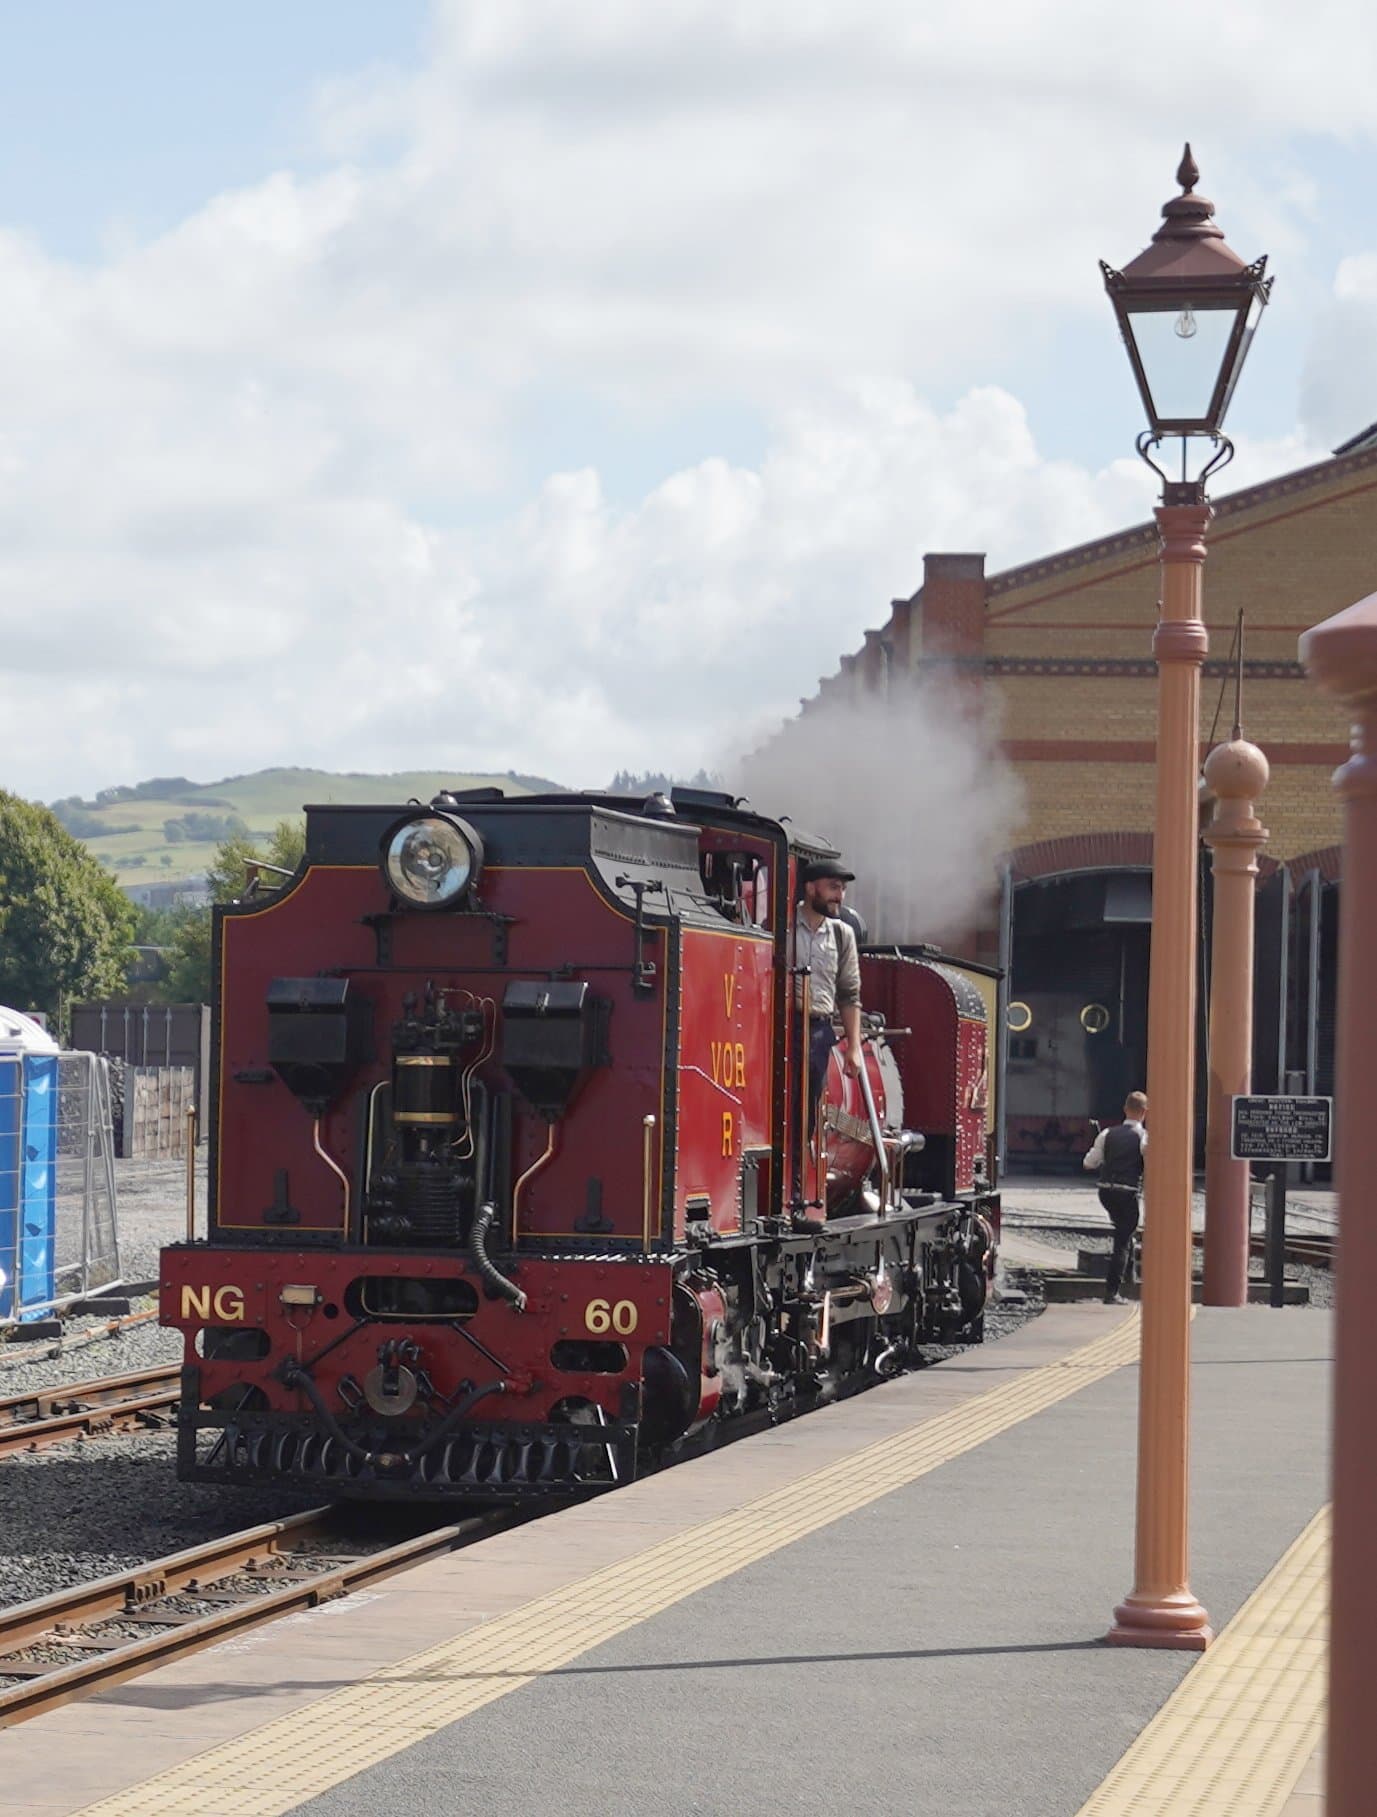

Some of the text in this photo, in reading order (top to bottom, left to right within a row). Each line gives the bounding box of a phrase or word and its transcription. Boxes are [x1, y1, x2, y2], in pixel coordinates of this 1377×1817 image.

[724, 973, 735, 1018] V
[721, 1111, 733, 1156] R
[181, 1285, 244, 1320] NG
[585, 1298, 638, 1335] 60
